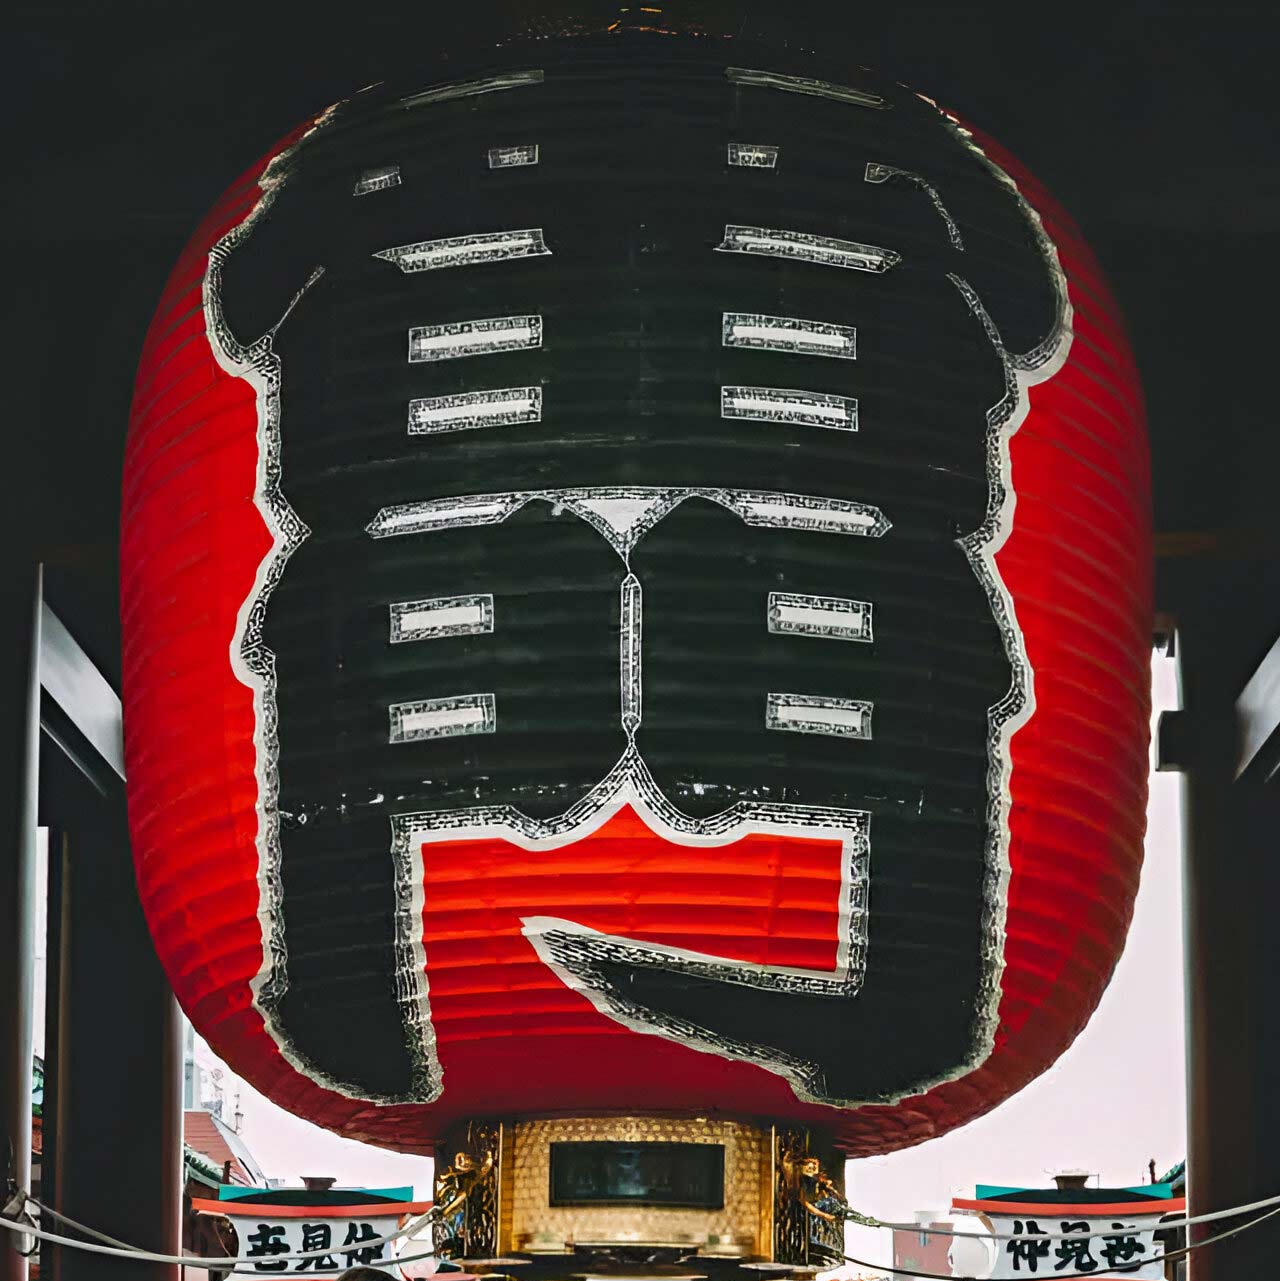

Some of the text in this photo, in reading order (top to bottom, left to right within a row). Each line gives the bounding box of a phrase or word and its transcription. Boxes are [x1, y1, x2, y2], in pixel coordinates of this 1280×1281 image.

[200, 42, 1074, 1108] 雷門
[1006, 1220, 1146, 1273] 仲見世
